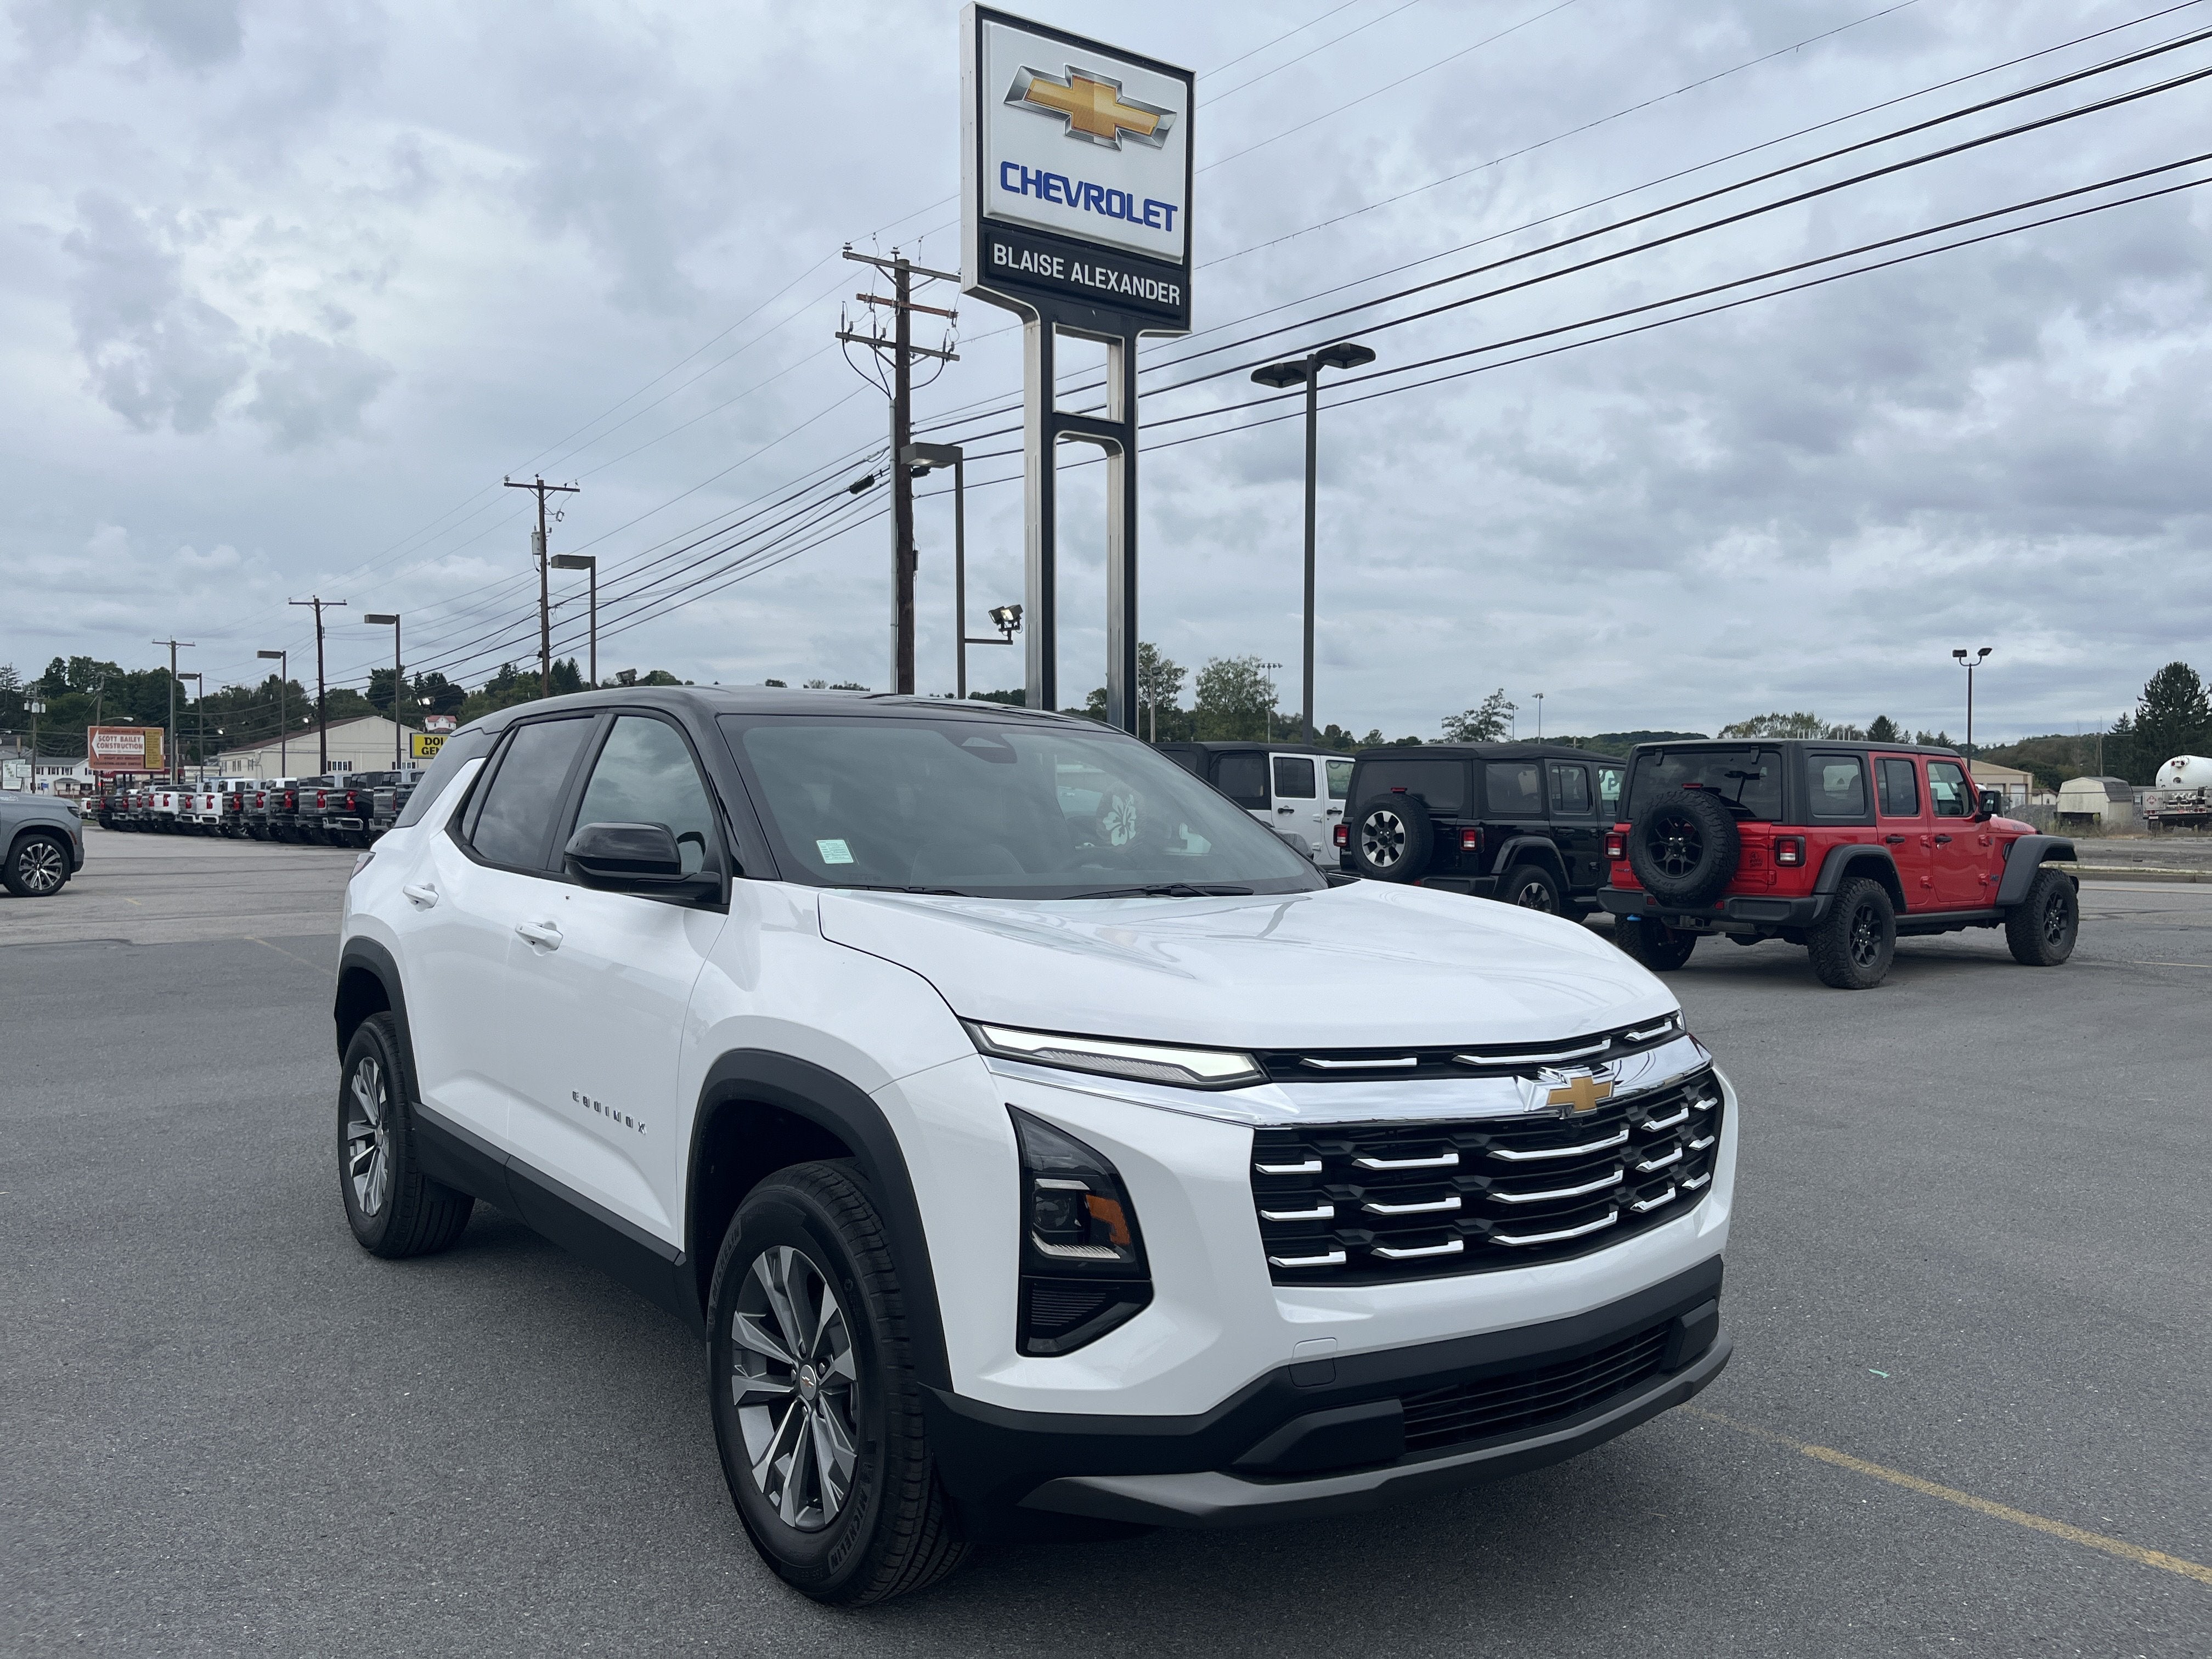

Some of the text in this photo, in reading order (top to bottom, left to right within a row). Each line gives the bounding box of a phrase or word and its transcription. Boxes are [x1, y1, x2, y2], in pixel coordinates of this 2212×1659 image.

[1001, 161, 1178, 232] CHEVROLET
[994, 243, 1180, 306] BLAISE ALEXANDER
[572, 1091, 646, 1135] EQUINOX
[712, 1223, 740, 1302] MICHELIN
[830, 1489, 867, 1570] MICHELIN
